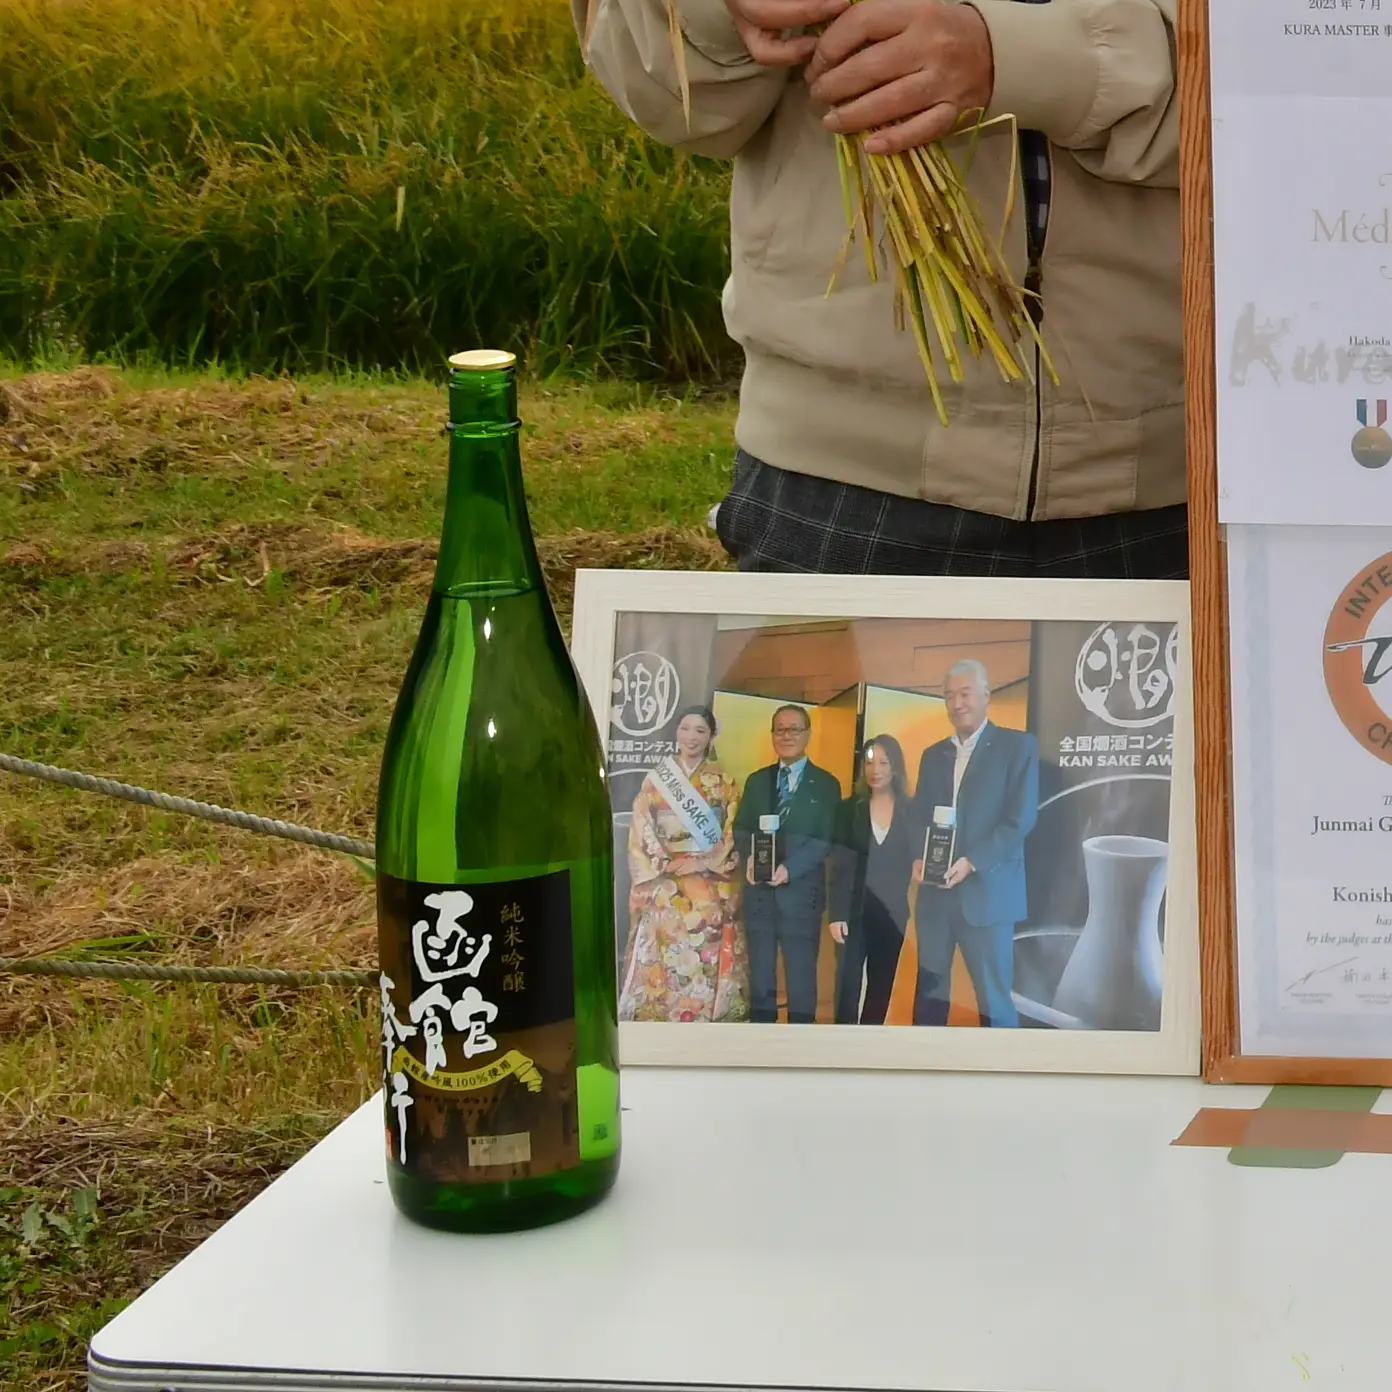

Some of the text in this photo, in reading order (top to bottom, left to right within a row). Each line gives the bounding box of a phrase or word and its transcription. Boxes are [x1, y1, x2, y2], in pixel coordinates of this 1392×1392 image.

[1284, 24, 1321, 35] KURA
[1325, 25, 1379, 36] MASTER
[616, 754, 641, 763] SAKE
[1059, 755, 1093, 767] KAN
[1097, 755, 1141, 767] SAKE
[681, 798, 709, 829] SAKE
[1311, 816, 1373, 835] Junmai
[500, 902, 526, 992] 純米吟醸
[408, 890, 498, 1075] 函館
